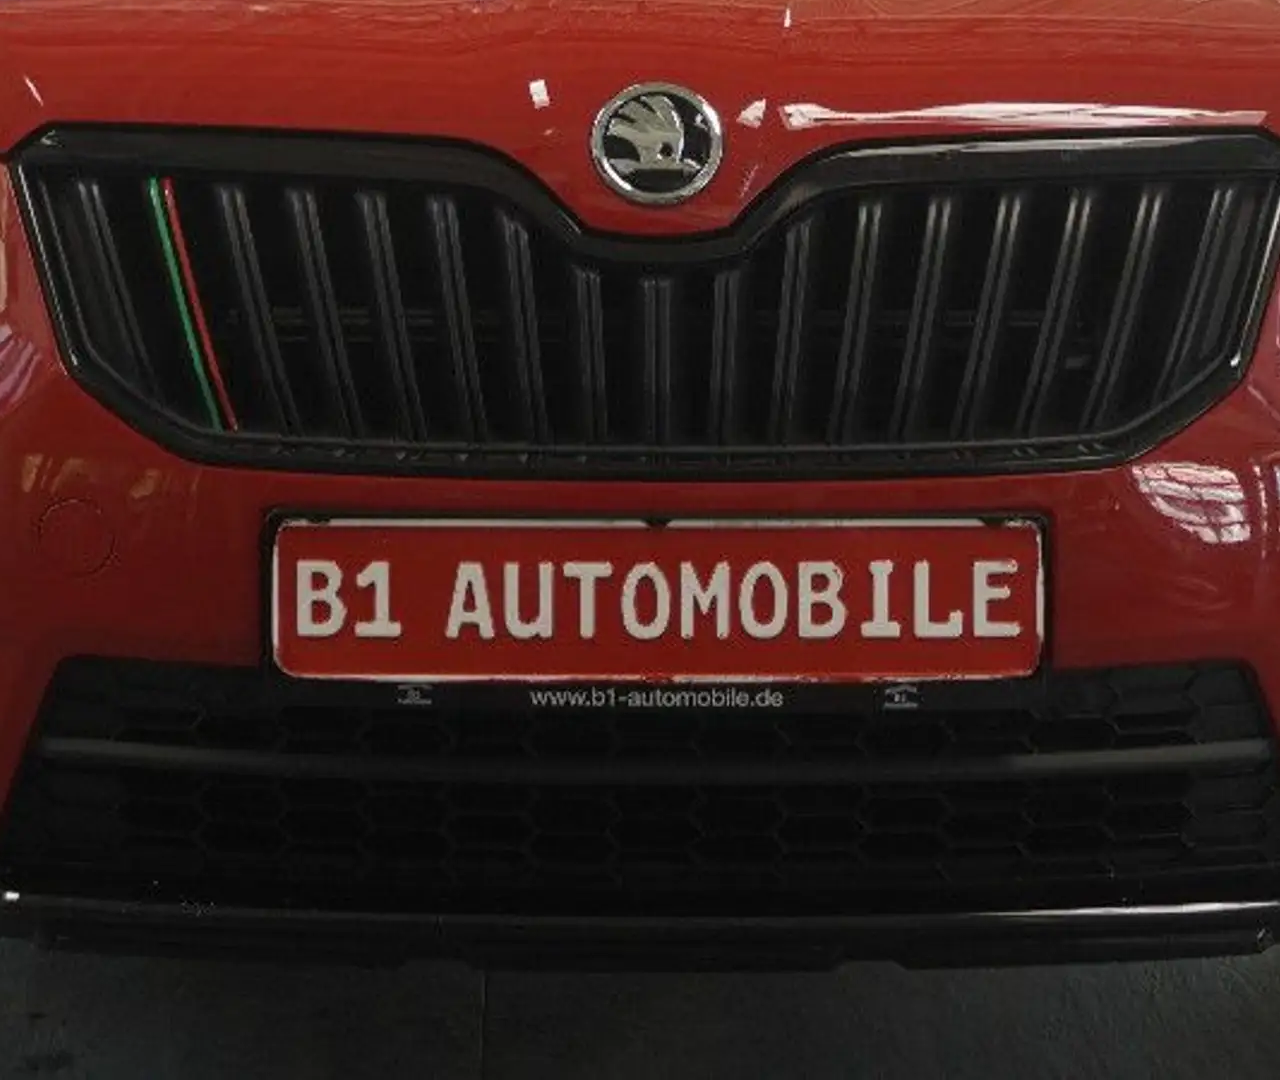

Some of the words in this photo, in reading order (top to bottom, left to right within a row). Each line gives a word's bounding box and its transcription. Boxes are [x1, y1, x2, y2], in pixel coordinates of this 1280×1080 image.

[295, 559, 403, 638] B1
[444, 559, 1023, 640] AUTOMOBILE
[528, 686, 785, 709] www.b1-automobile.de
